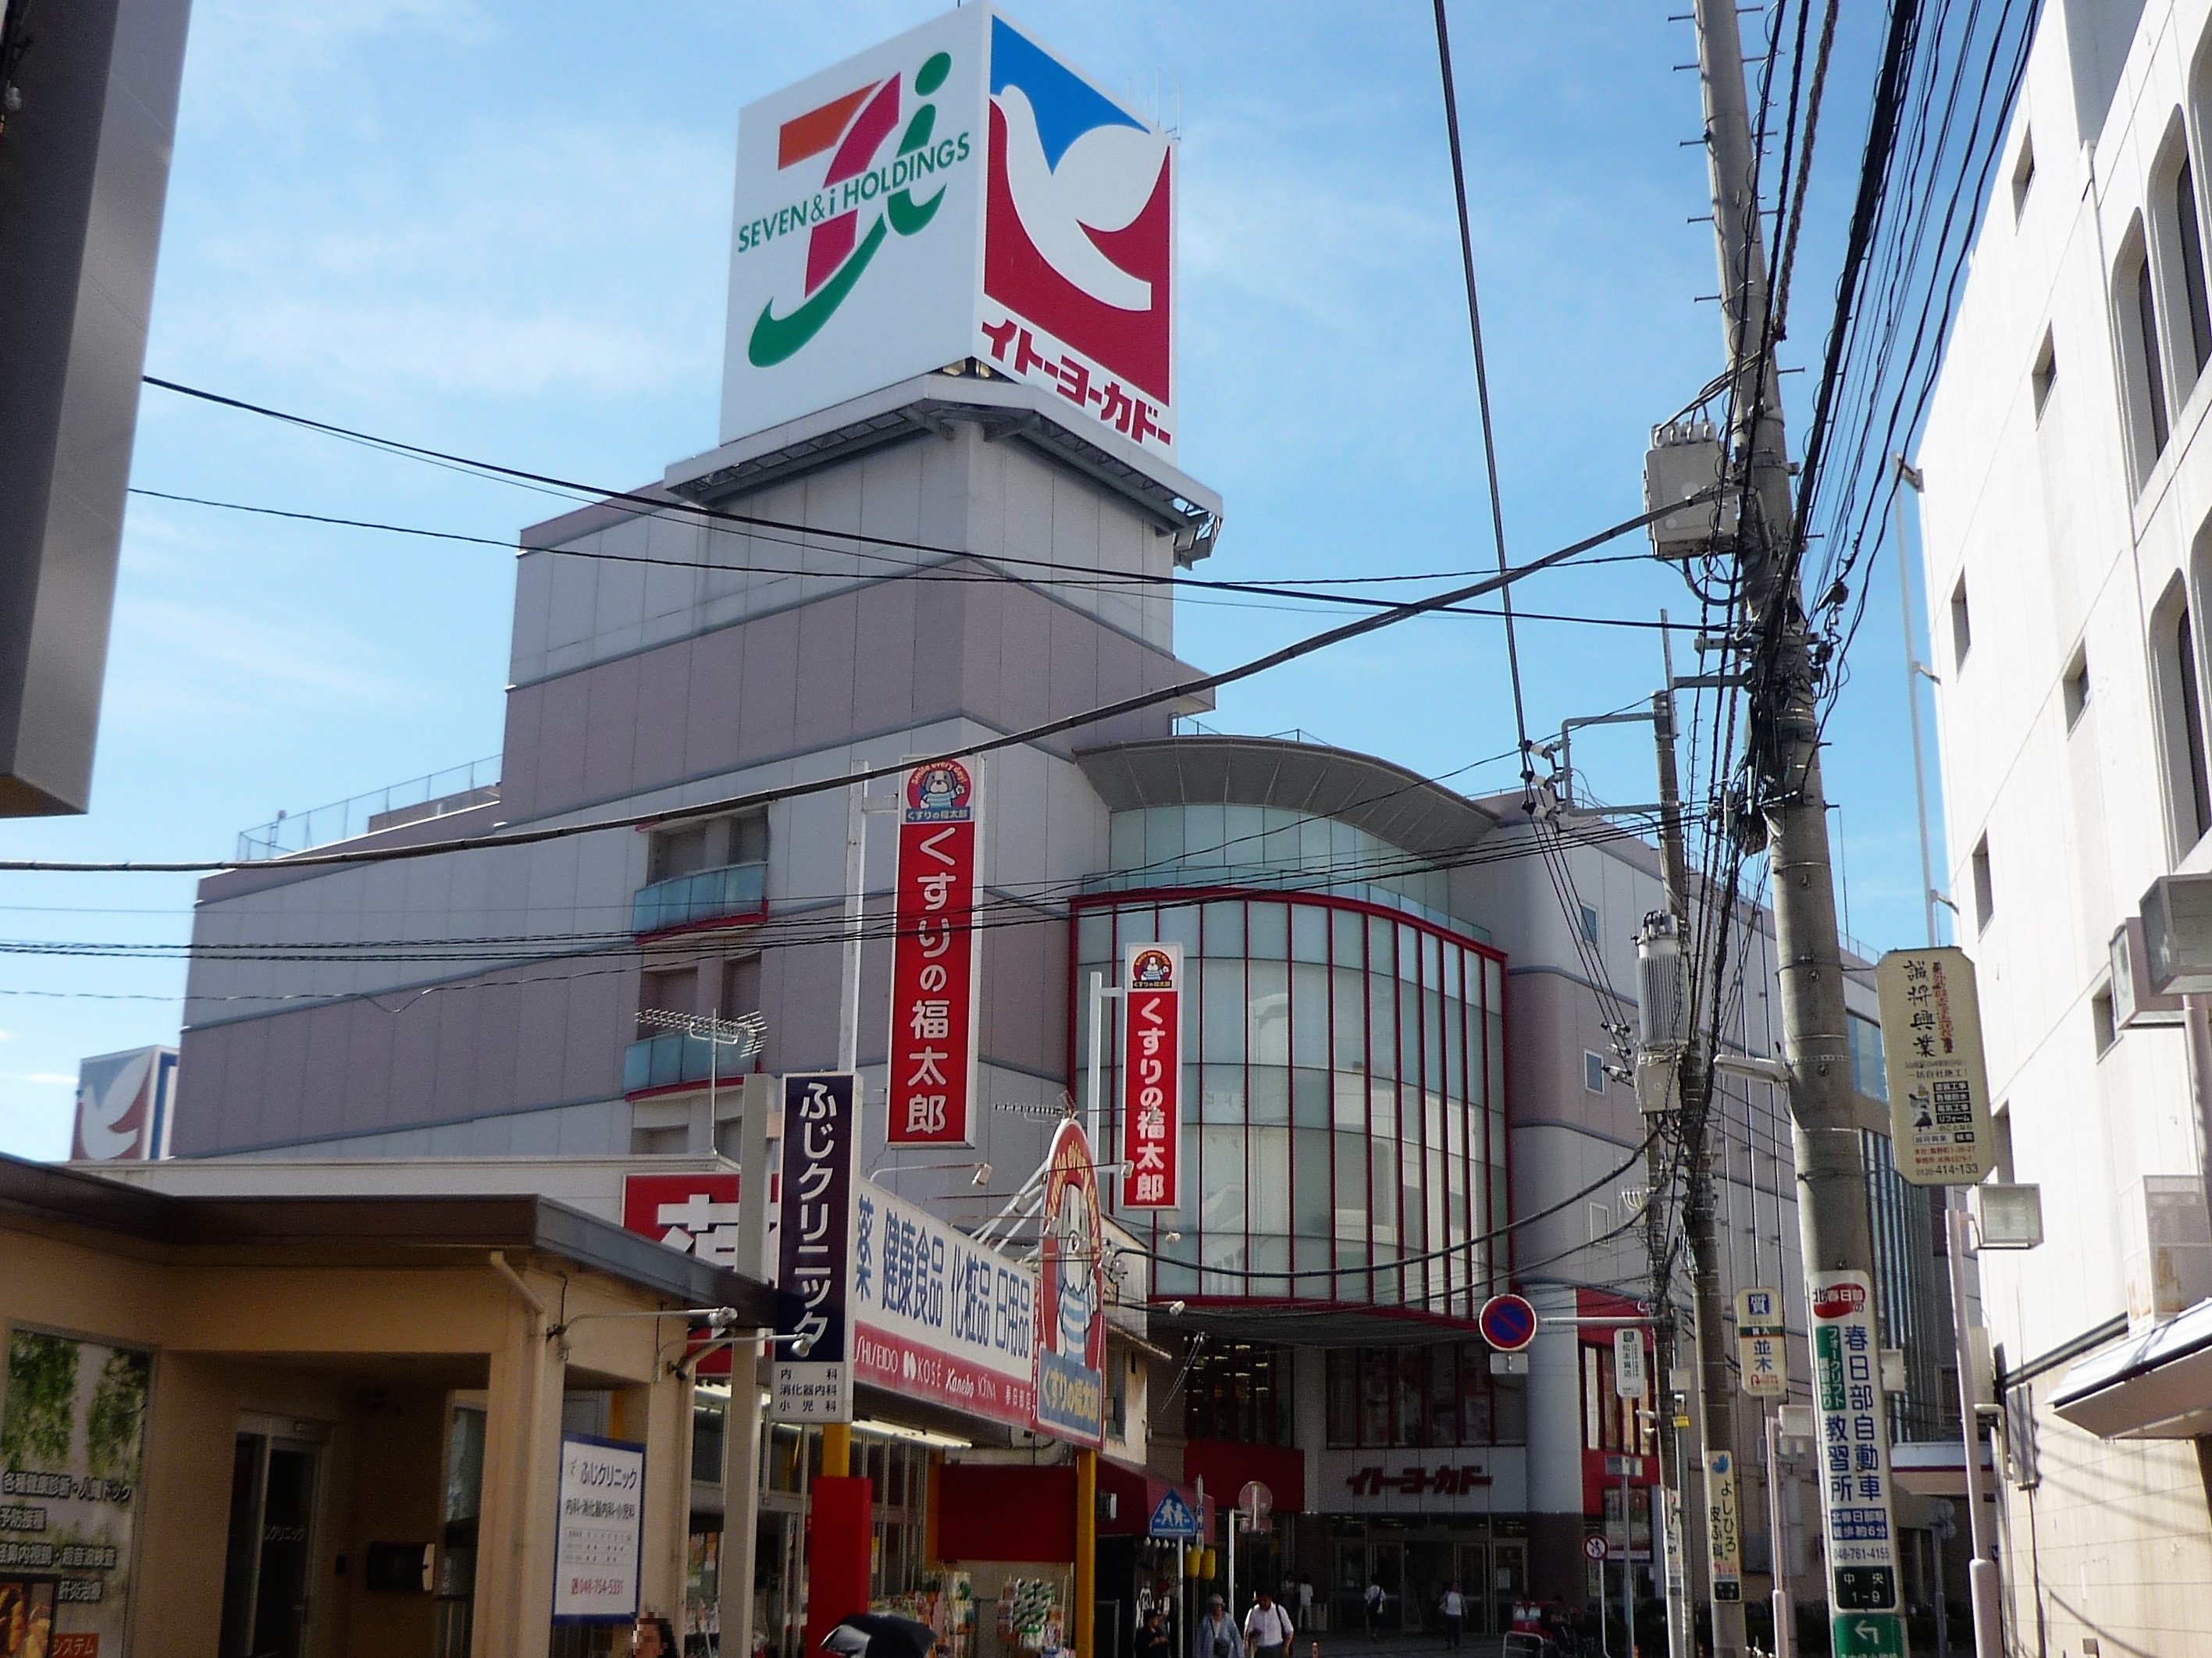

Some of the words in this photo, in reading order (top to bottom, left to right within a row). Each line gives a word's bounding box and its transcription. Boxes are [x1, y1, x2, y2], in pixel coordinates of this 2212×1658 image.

[843, 131, 971, 206] HOLDINGS
[981, 318, 1171, 446] イトーヨーカドー
[931, 762, 953, 771] every
[907, 809, 967, 820] くすりの福太郎
[906, 826, 956, 1134] くすりの福太郎
[1136, 997, 1166, 1201] くすりの福太郎
[794, 1082, 837, 1350] ふじクリニック
[856, 1194, 874, 1301] 薬
[882, 1207, 945, 1328] 健康食品
[951, 1244, 991, 1347] 化粧品
[1750, 1295, 1767, 1314] 質
[1813, 1287, 1864, 1303] 北春日部
[996, 1267, 1030, 1358] 日用品
[780, 1383, 836, 1396] 消化器内科
[855, 1336, 897, 1373] SHISEIDO
[946, 1368, 974, 1398] Kanebo
[1754, 1340, 1772, 1373] 並木
[1827, 1328, 1845, 1407] フォークリフト
[1844, 1324, 1881, 1501] 春日部自動車
[581, 1461, 637, 1489] ふじクリニック
[1347, 1464, 1493, 1496] イトーヨーカドー
[1826, 1414, 1854, 1502] 教習所
[1834, 1547, 1890, 1560] 048-761-4155
